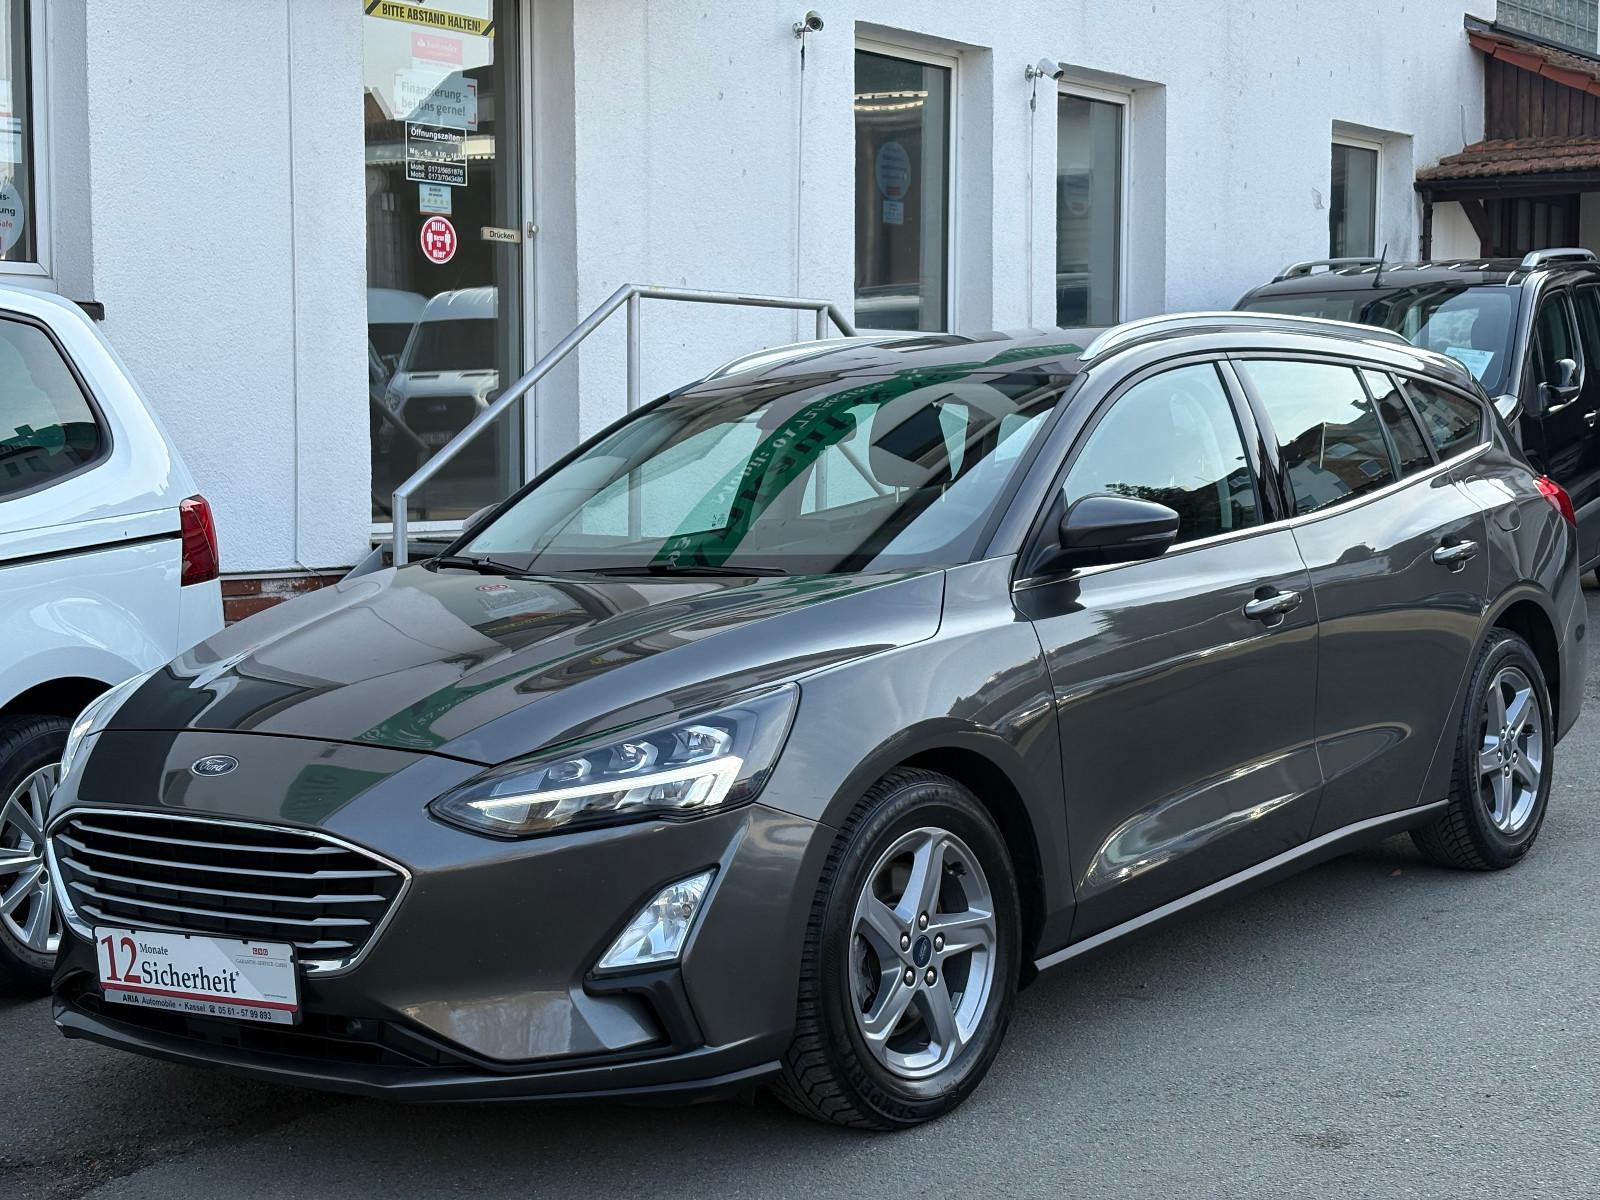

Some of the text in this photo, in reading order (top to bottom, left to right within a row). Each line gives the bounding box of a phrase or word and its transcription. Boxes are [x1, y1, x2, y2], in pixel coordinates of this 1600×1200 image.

[382, 3, 481, 32] BITTE ABSTAND HALTEN!
[418, 103, 435, 112] uns
[436, 105, 466, 116] gerne!
[489, 230, 515, 240] Drücken
[199, 758, 228, 772] Ford
[139, 942, 169, 956] Monate
[101, 935, 142, 984] 12
[122, 993, 140, 1004] ARIA
[142, 996, 176, 1009] Automobile
[184, 1001, 206, 1012] Kassel
